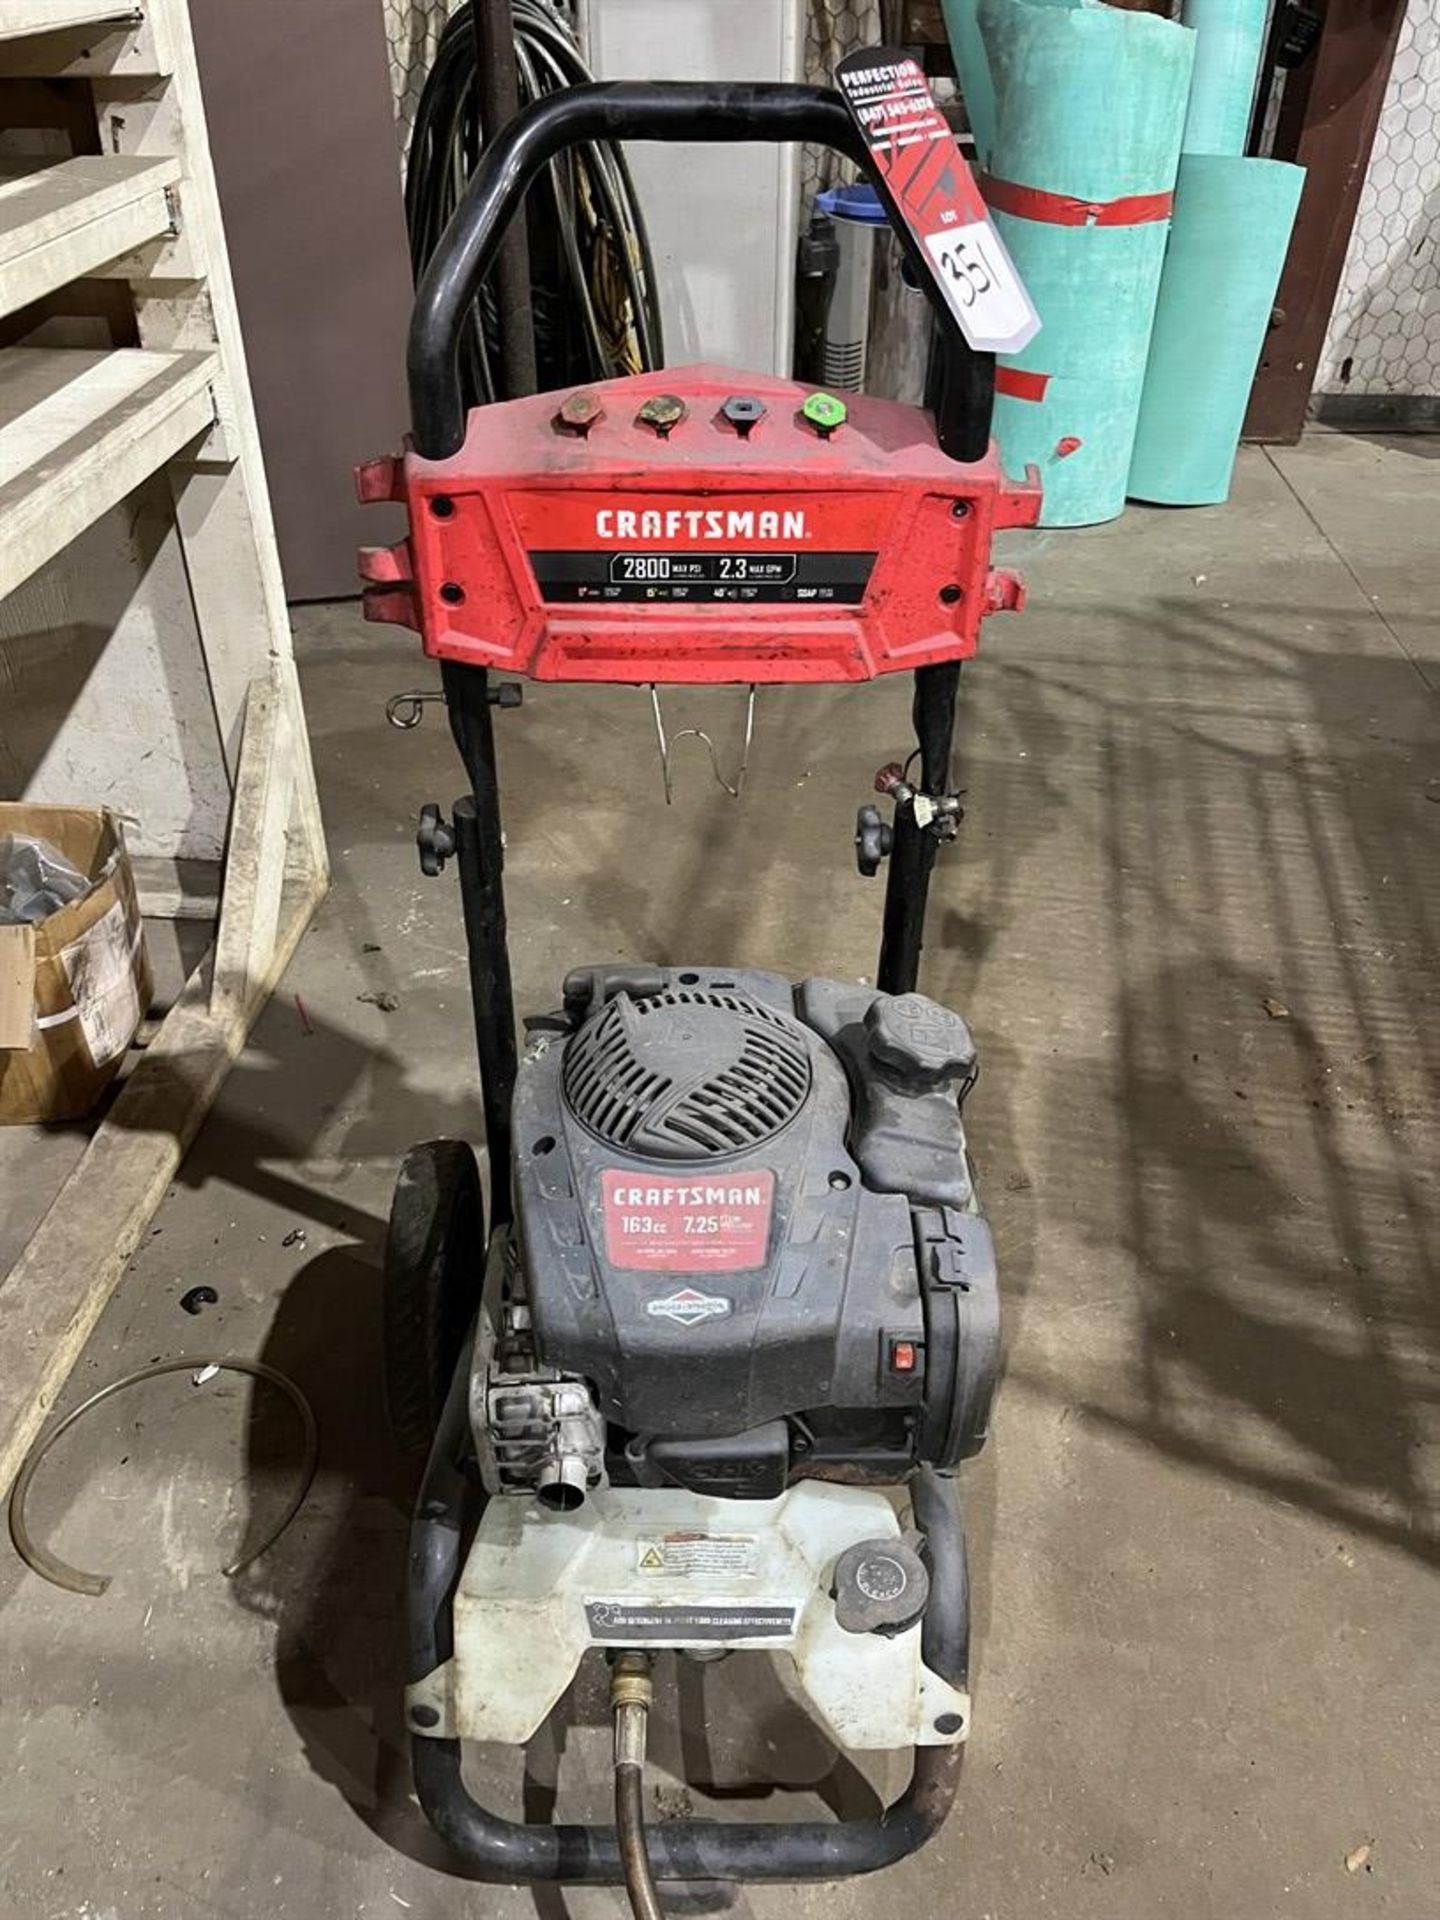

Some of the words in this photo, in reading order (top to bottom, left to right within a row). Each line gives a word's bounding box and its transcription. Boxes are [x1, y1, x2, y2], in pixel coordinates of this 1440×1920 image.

[841, 63, 917, 87] PERFECTION
[847, 81, 896, 97] Industrial
[940, 209, 958, 223] LOT
[941, 242, 1002, 307] 351
[596, 510, 805, 539] CRAFTSMAN
[623, 558, 670, 579] 2800
[672, 564, 687, 573] MAX
[719, 558, 747, 579] 2.3
[613, 1187, 760, 1206] CRAFTSMAN
[683, 1216, 718, 1234] 7.25
